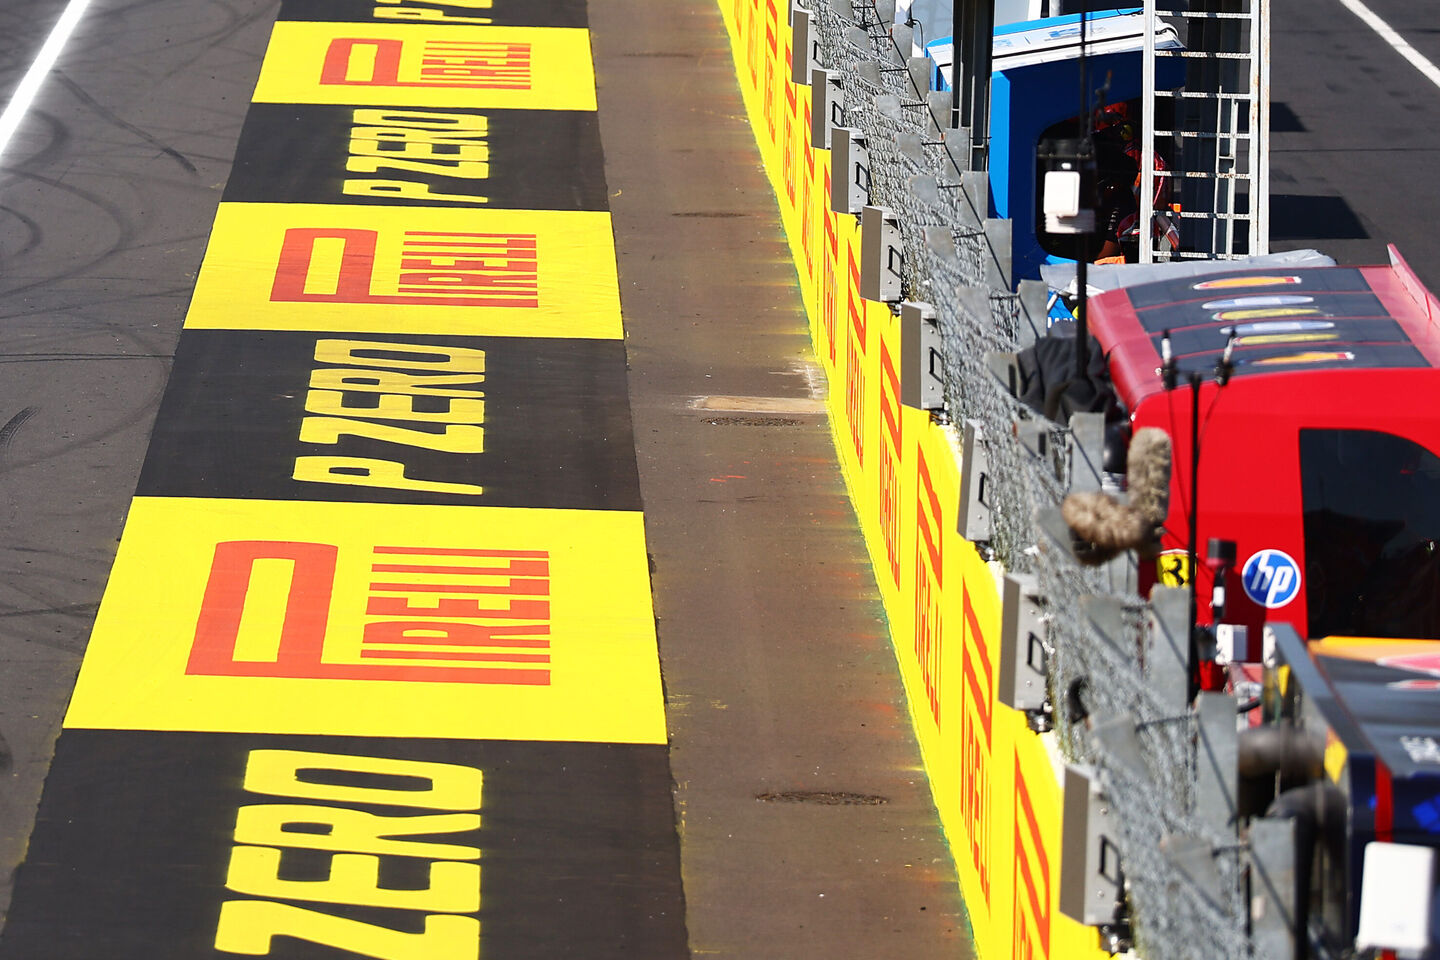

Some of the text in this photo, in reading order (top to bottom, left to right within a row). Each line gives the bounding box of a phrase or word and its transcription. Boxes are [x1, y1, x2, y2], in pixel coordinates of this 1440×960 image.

[319, 38, 532, 90] PIRELLI
[342, 108, 489, 204] P ZERO
[269, 228, 539, 308] PIRELLI
[291, 338, 486, 496] P ZERO
[879, 333, 902, 592] PIRELLI
[184, 540, 551, 686] PIRELLI
[914, 440, 943, 736] PIRELLI
[1251, 554, 1294, 605] hp
[961, 577, 992, 919] PIRELLI
[214, 749, 484, 960] ZERO
